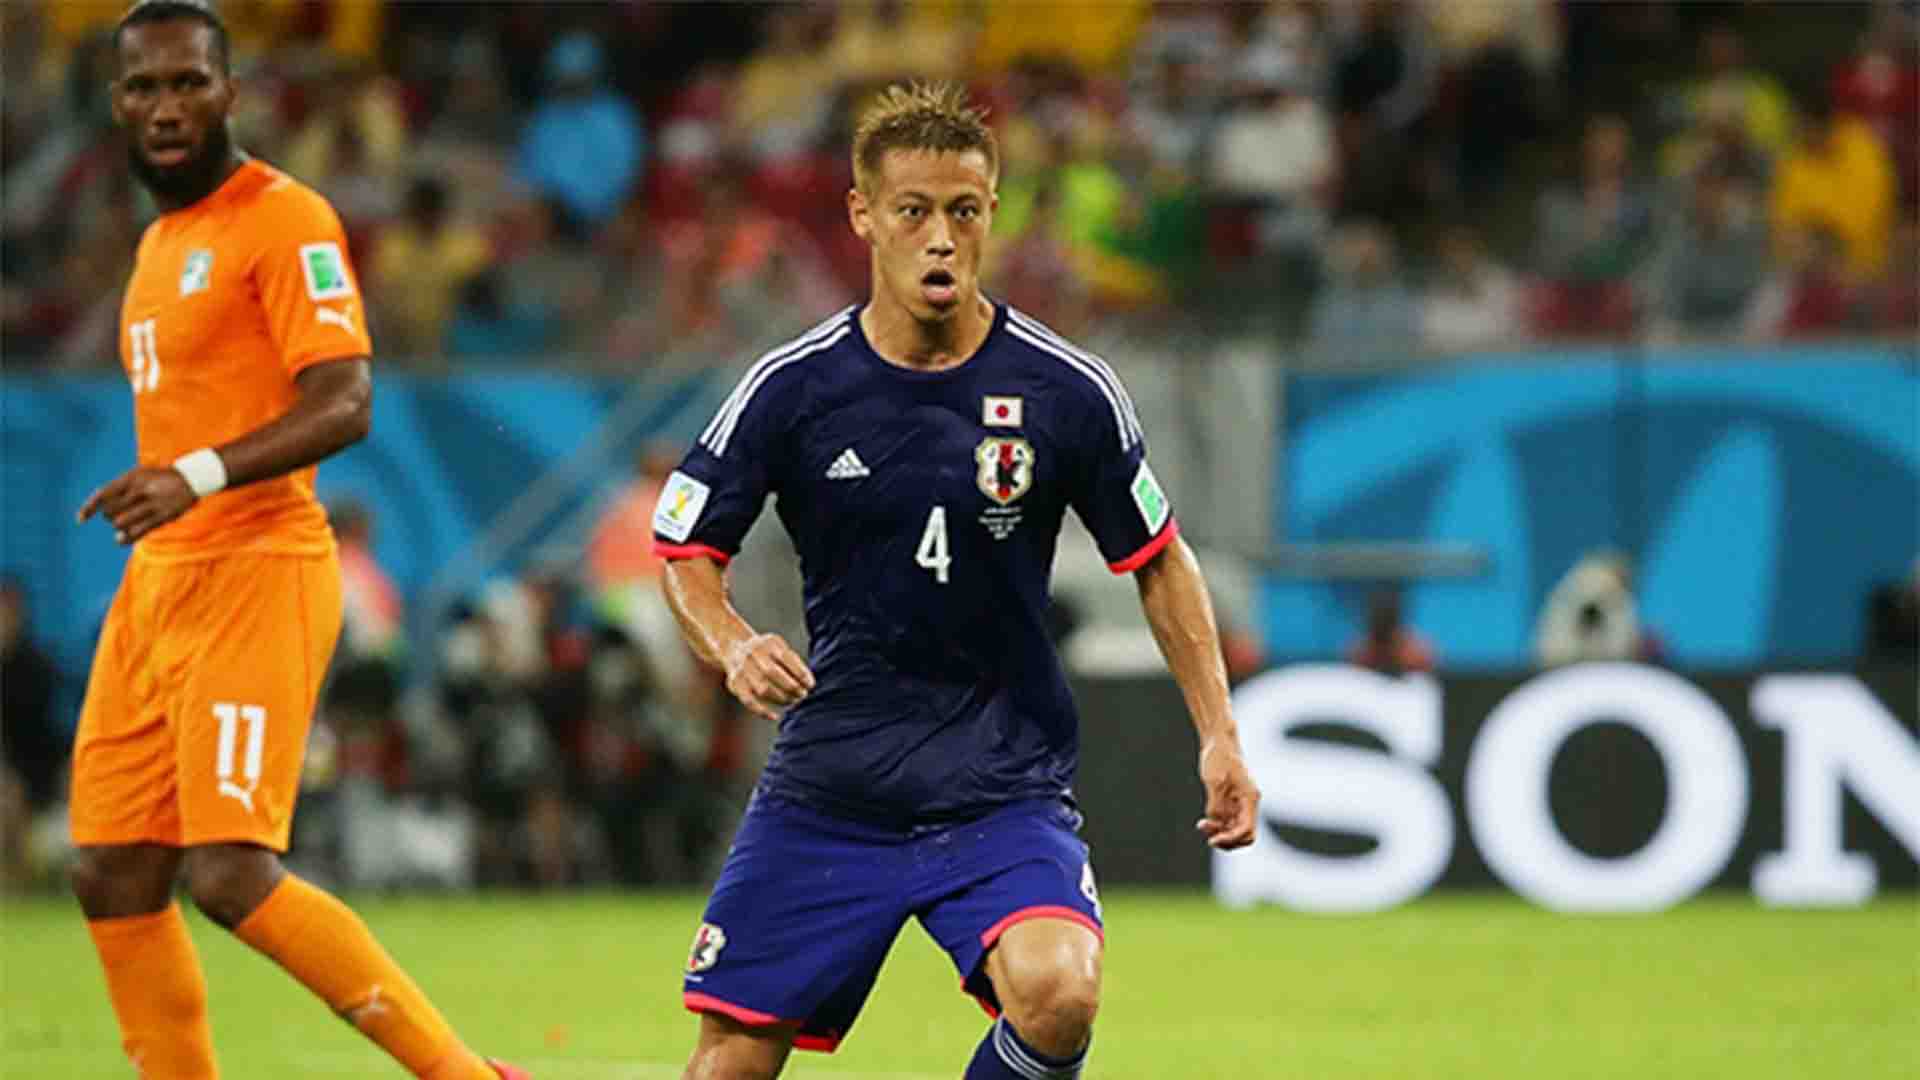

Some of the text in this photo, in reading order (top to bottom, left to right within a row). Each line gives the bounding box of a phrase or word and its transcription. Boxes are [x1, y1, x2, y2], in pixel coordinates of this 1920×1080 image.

[129, 321, 160, 393] 11
[915, 506, 952, 582] 4
[212, 703, 265, 782] 11
